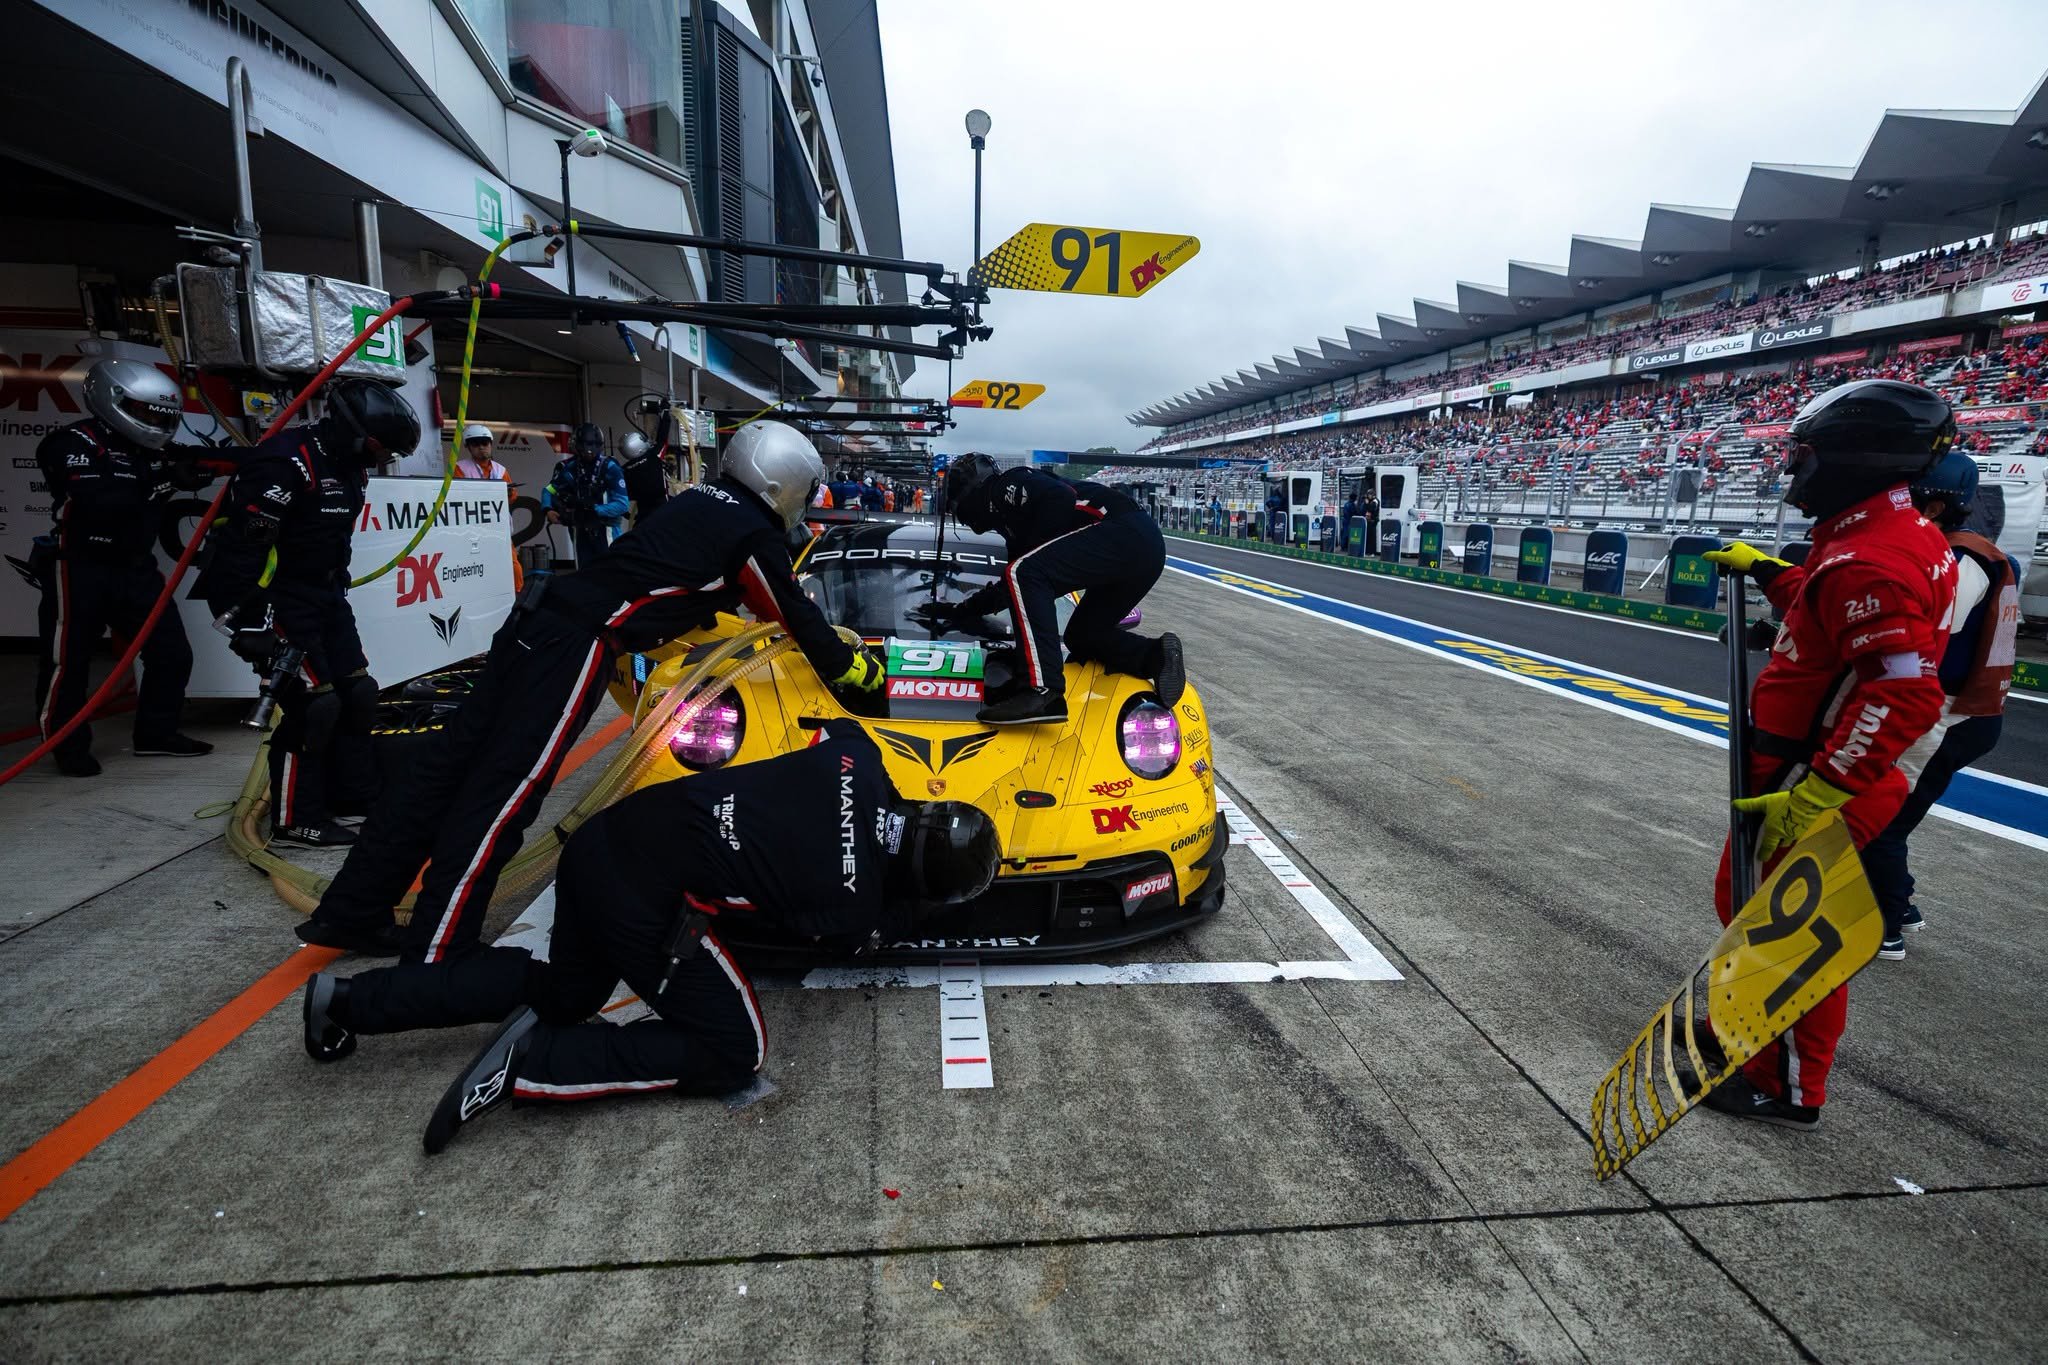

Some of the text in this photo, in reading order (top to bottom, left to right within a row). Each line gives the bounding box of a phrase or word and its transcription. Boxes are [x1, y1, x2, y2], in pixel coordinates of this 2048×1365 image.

[480, 192, 499, 233] 91
[1051, 227, 1194, 294] 91 DK Engineering
[364, 314, 400, 361] 91
[1775, 325, 1824, 342] LEXUS
[2008, 325, 2038, 336] TOYOTA
[1705, 340, 1745, 354] LEXUS
[1902, 342, 1927, 351] TOYOTA
[1645, 352, 1680, 366] LEXUS
[987, 382, 1021, 409] 92
[148, 404, 181, 415] MANT
[0, 418, 65, 437] ineeri
[693, 483, 740, 505] ANTHEY
[386, 500, 504, 530] MANTHEY
[1382, 532, 1398, 541] WEC
[1467, 540, 1488, 551] WEC
[810, 548, 1009, 566] PORSCH
[1524, 555, 1545, 563] ROLEX
[1587, 551, 1621, 564] WEC
[396, 552, 484, 608] DK Engineering
[1677, 571, 1706, 583] ROLEX
[1618, 608, 1634, 616] ROLEX
[1844, 593, 1880, 618] 24h
[1650, 614, 1668, 622] ROLEX
[1856, 607, 1881, 622] MANS
[1685, 619, 1705, 628] ROLEX
[1852, 633, 1870, 649] DK
[901, 649, 969, 673] 91
[1434, 639, 1728, 730] OODYEAR
[2010, 673, 2040, 687] OLEX
[890, 681, 981, 698] MOTUL
[1828, 703, 1890, 776] MOTUL
[1090, 801, 1189, 834] DK Engineering
[840, 775, 856, 894] MANTHEY
[875, 807, 886, 846] HRX
[1170, 820, 1216, 853] GOODYEA
[1128, 875, 1171, 899] MOTUL
[891, 935, 1041, 949] ANHEY
[1746, 855, 1843, 1019] 91
